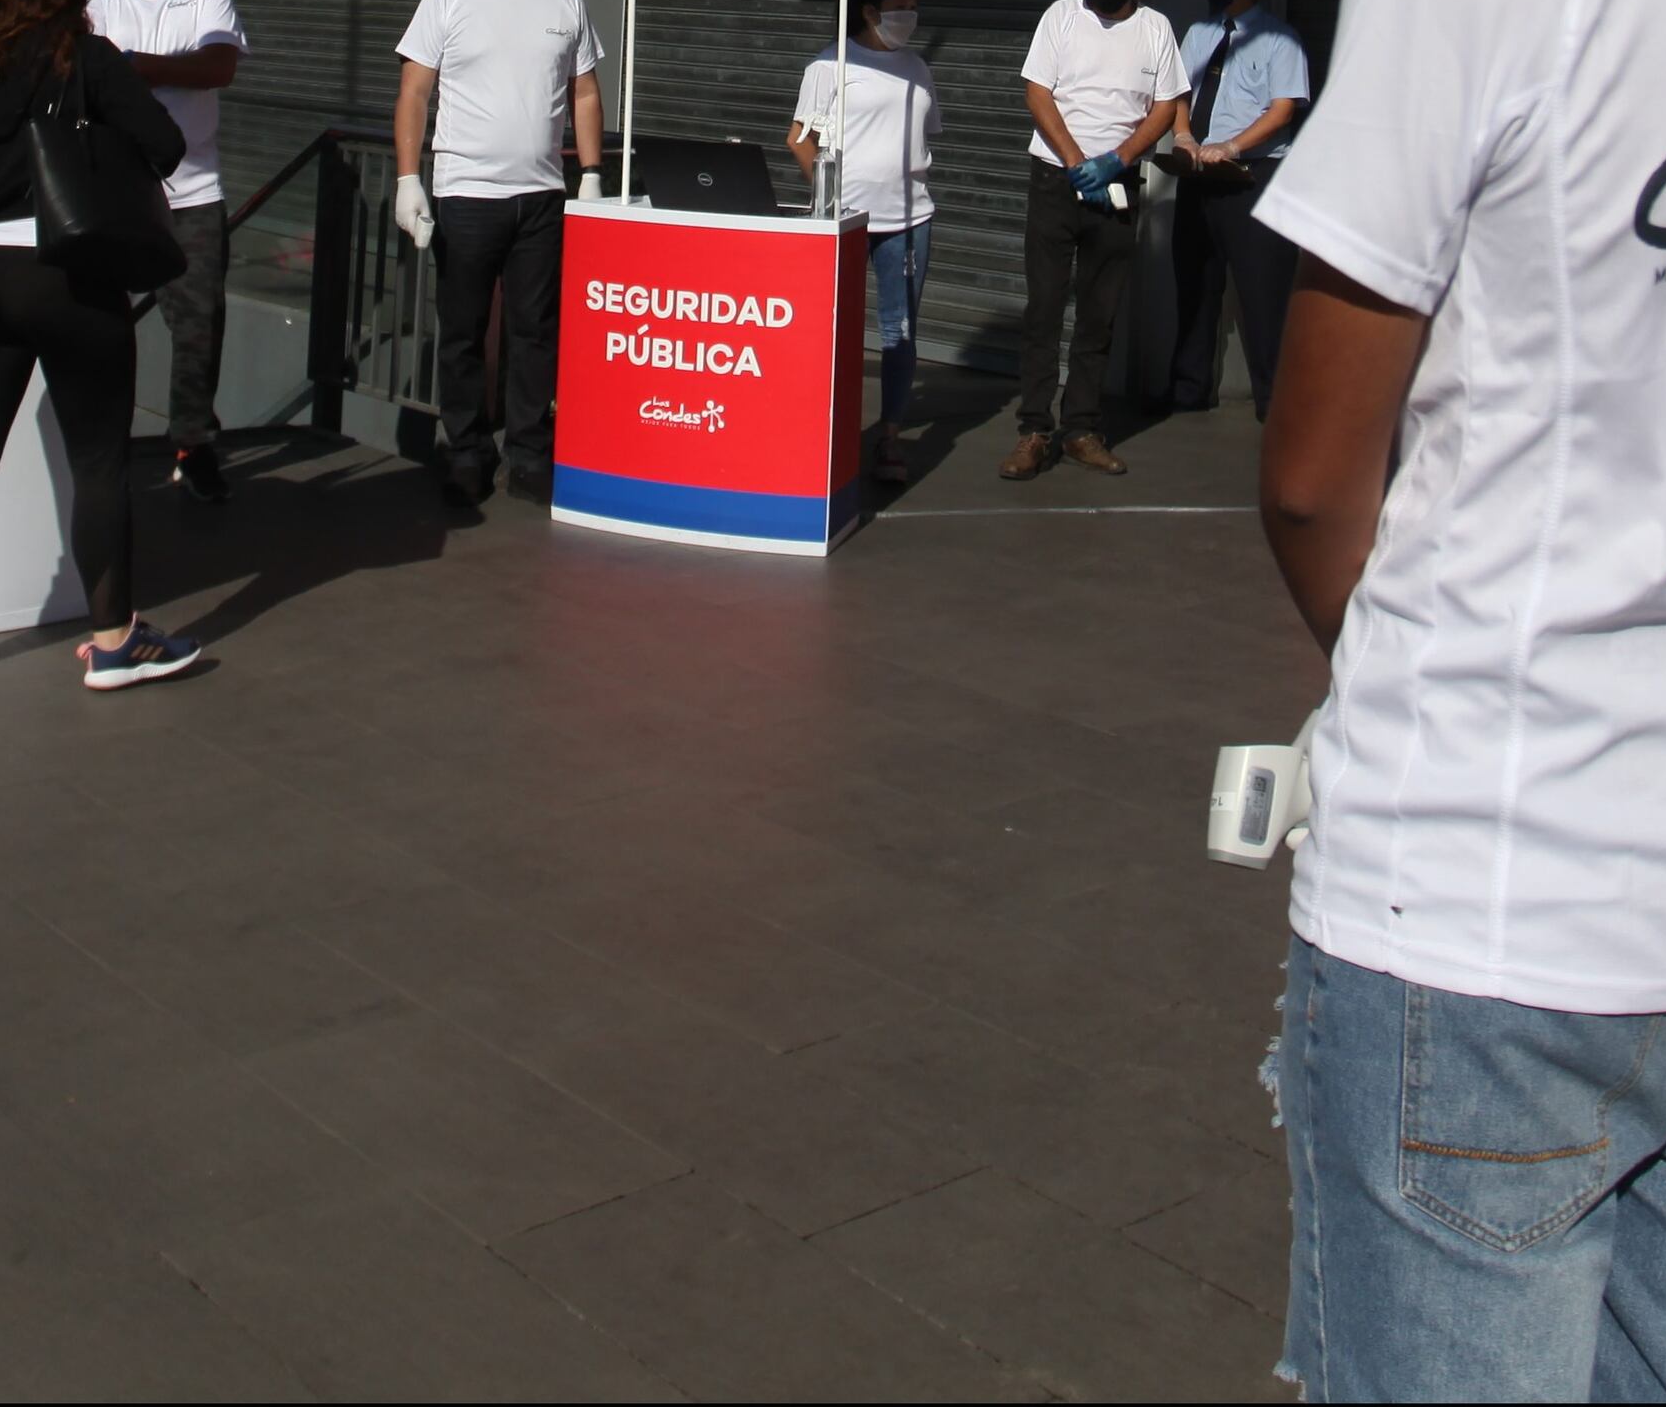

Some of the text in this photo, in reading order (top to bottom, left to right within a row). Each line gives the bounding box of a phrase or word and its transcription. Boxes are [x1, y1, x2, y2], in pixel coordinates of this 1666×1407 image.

[585, 280, 793, 328] SEGURIDAD
[605, 324, 762, 377] PÚBLICA
[639, 400, 702, 424] Condes
